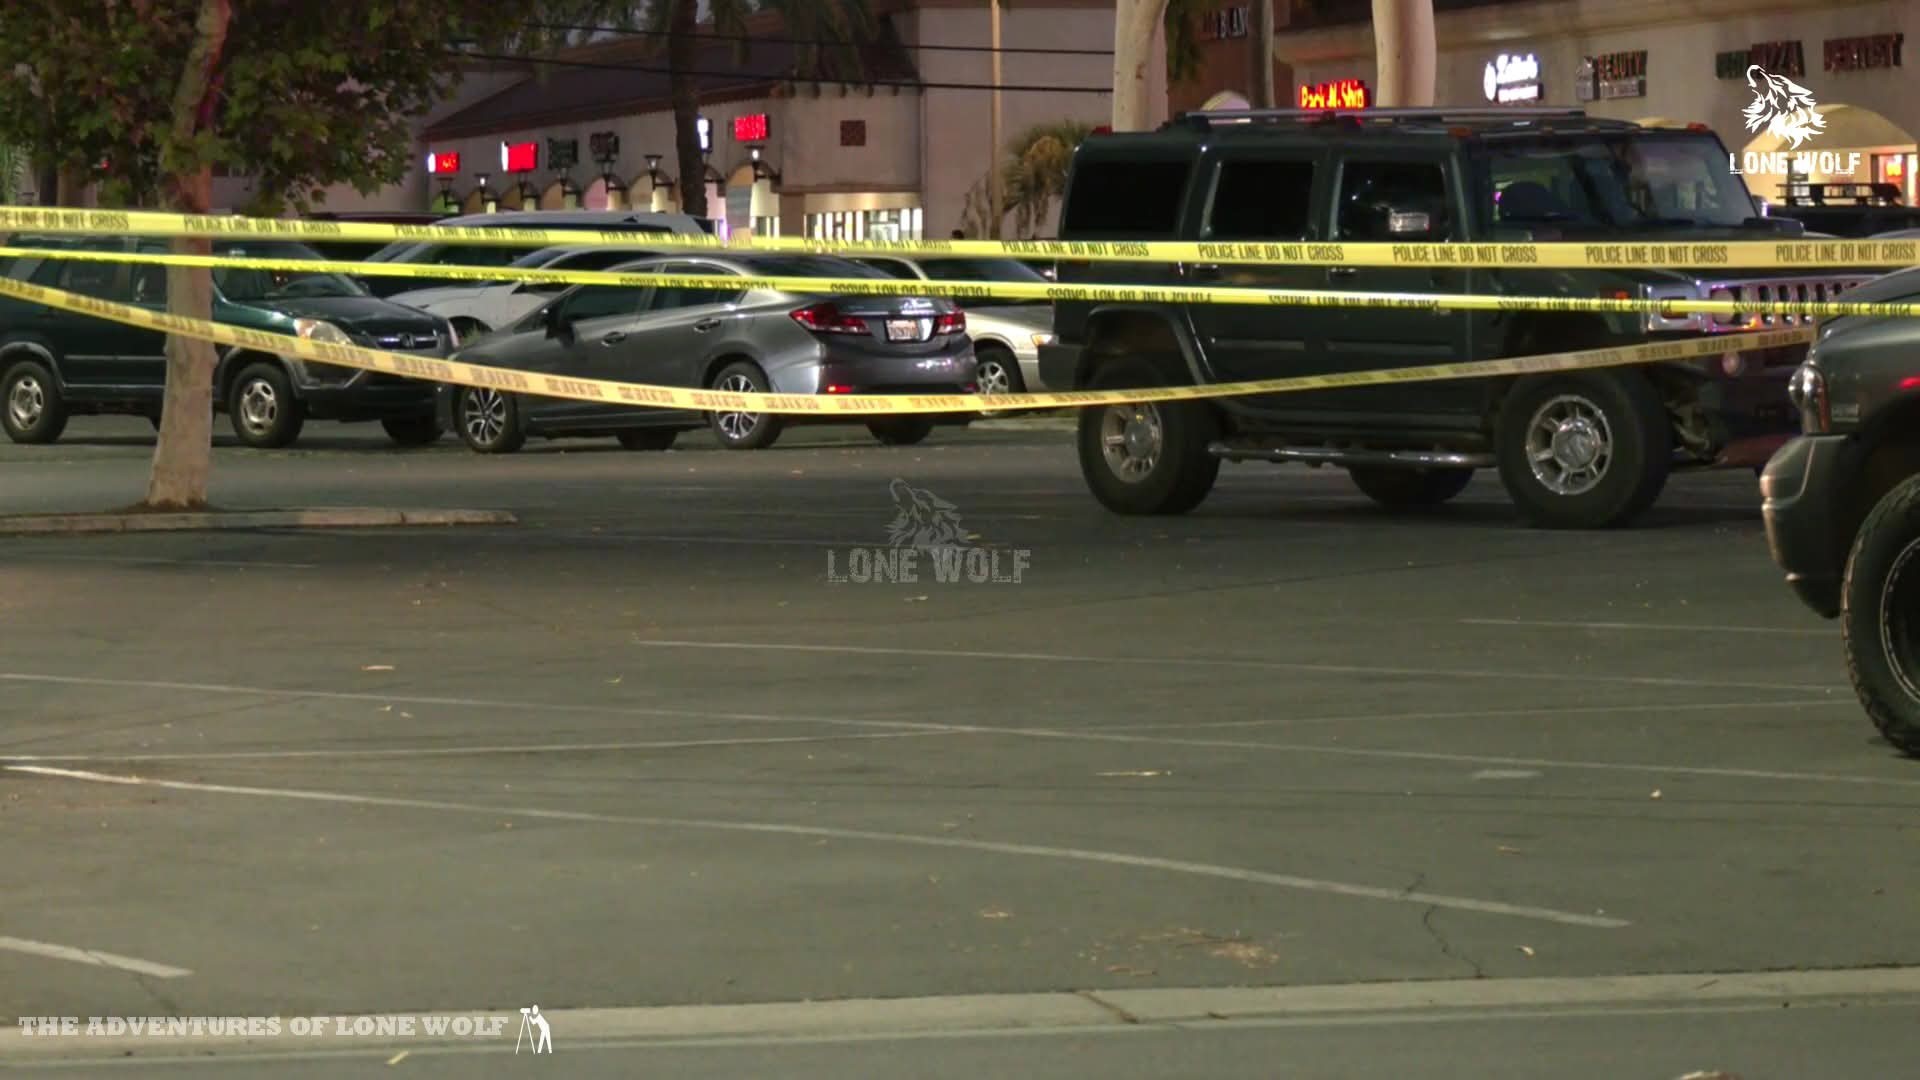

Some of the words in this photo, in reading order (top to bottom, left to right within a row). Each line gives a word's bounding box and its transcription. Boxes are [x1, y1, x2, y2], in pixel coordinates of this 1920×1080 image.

[1002, 241, 1040, 253] POLICE
[1042, 242, 1065, 254] LINE
[1070, 242, 1084, 255] DO
[1088, 242, 1109, 255] NOT
[1112, 242, 1149, 256] CROSS
[1198, 244, 1236, 259] POLICE
[1239, 244, 1262, 259] LINE
[1264, 245, 1280, 260] DO
[1283, 245, 1304, 260] NOT
[1307, 245, 1344, 261] CROSS
[1393, 245, 1431, 262] POLICE
[1433, 246, 1456, 262] LINE
[1460, 246, 1474, 262] DO
[1477, 246, 1498, 262] NOT
[1501, 246, 1537, 263] CROSS
[1585, 246, 1622, 264] POLICE
[1625, 246, 1649, 263] LINE
[1651, 246, 1665, 263] DO
[1669, 246, 1689, 263] NOT
[1692, 245, 1727, 263] CROSS
[1776, 245, 1811, 262] POLICE
[1815, 244, 1837, 262] LINE
[1840, 244, 1854, 261] DO
[1858, 243, 1878, 261] NOT
[1881, 243, 1916, 261] CROSS
